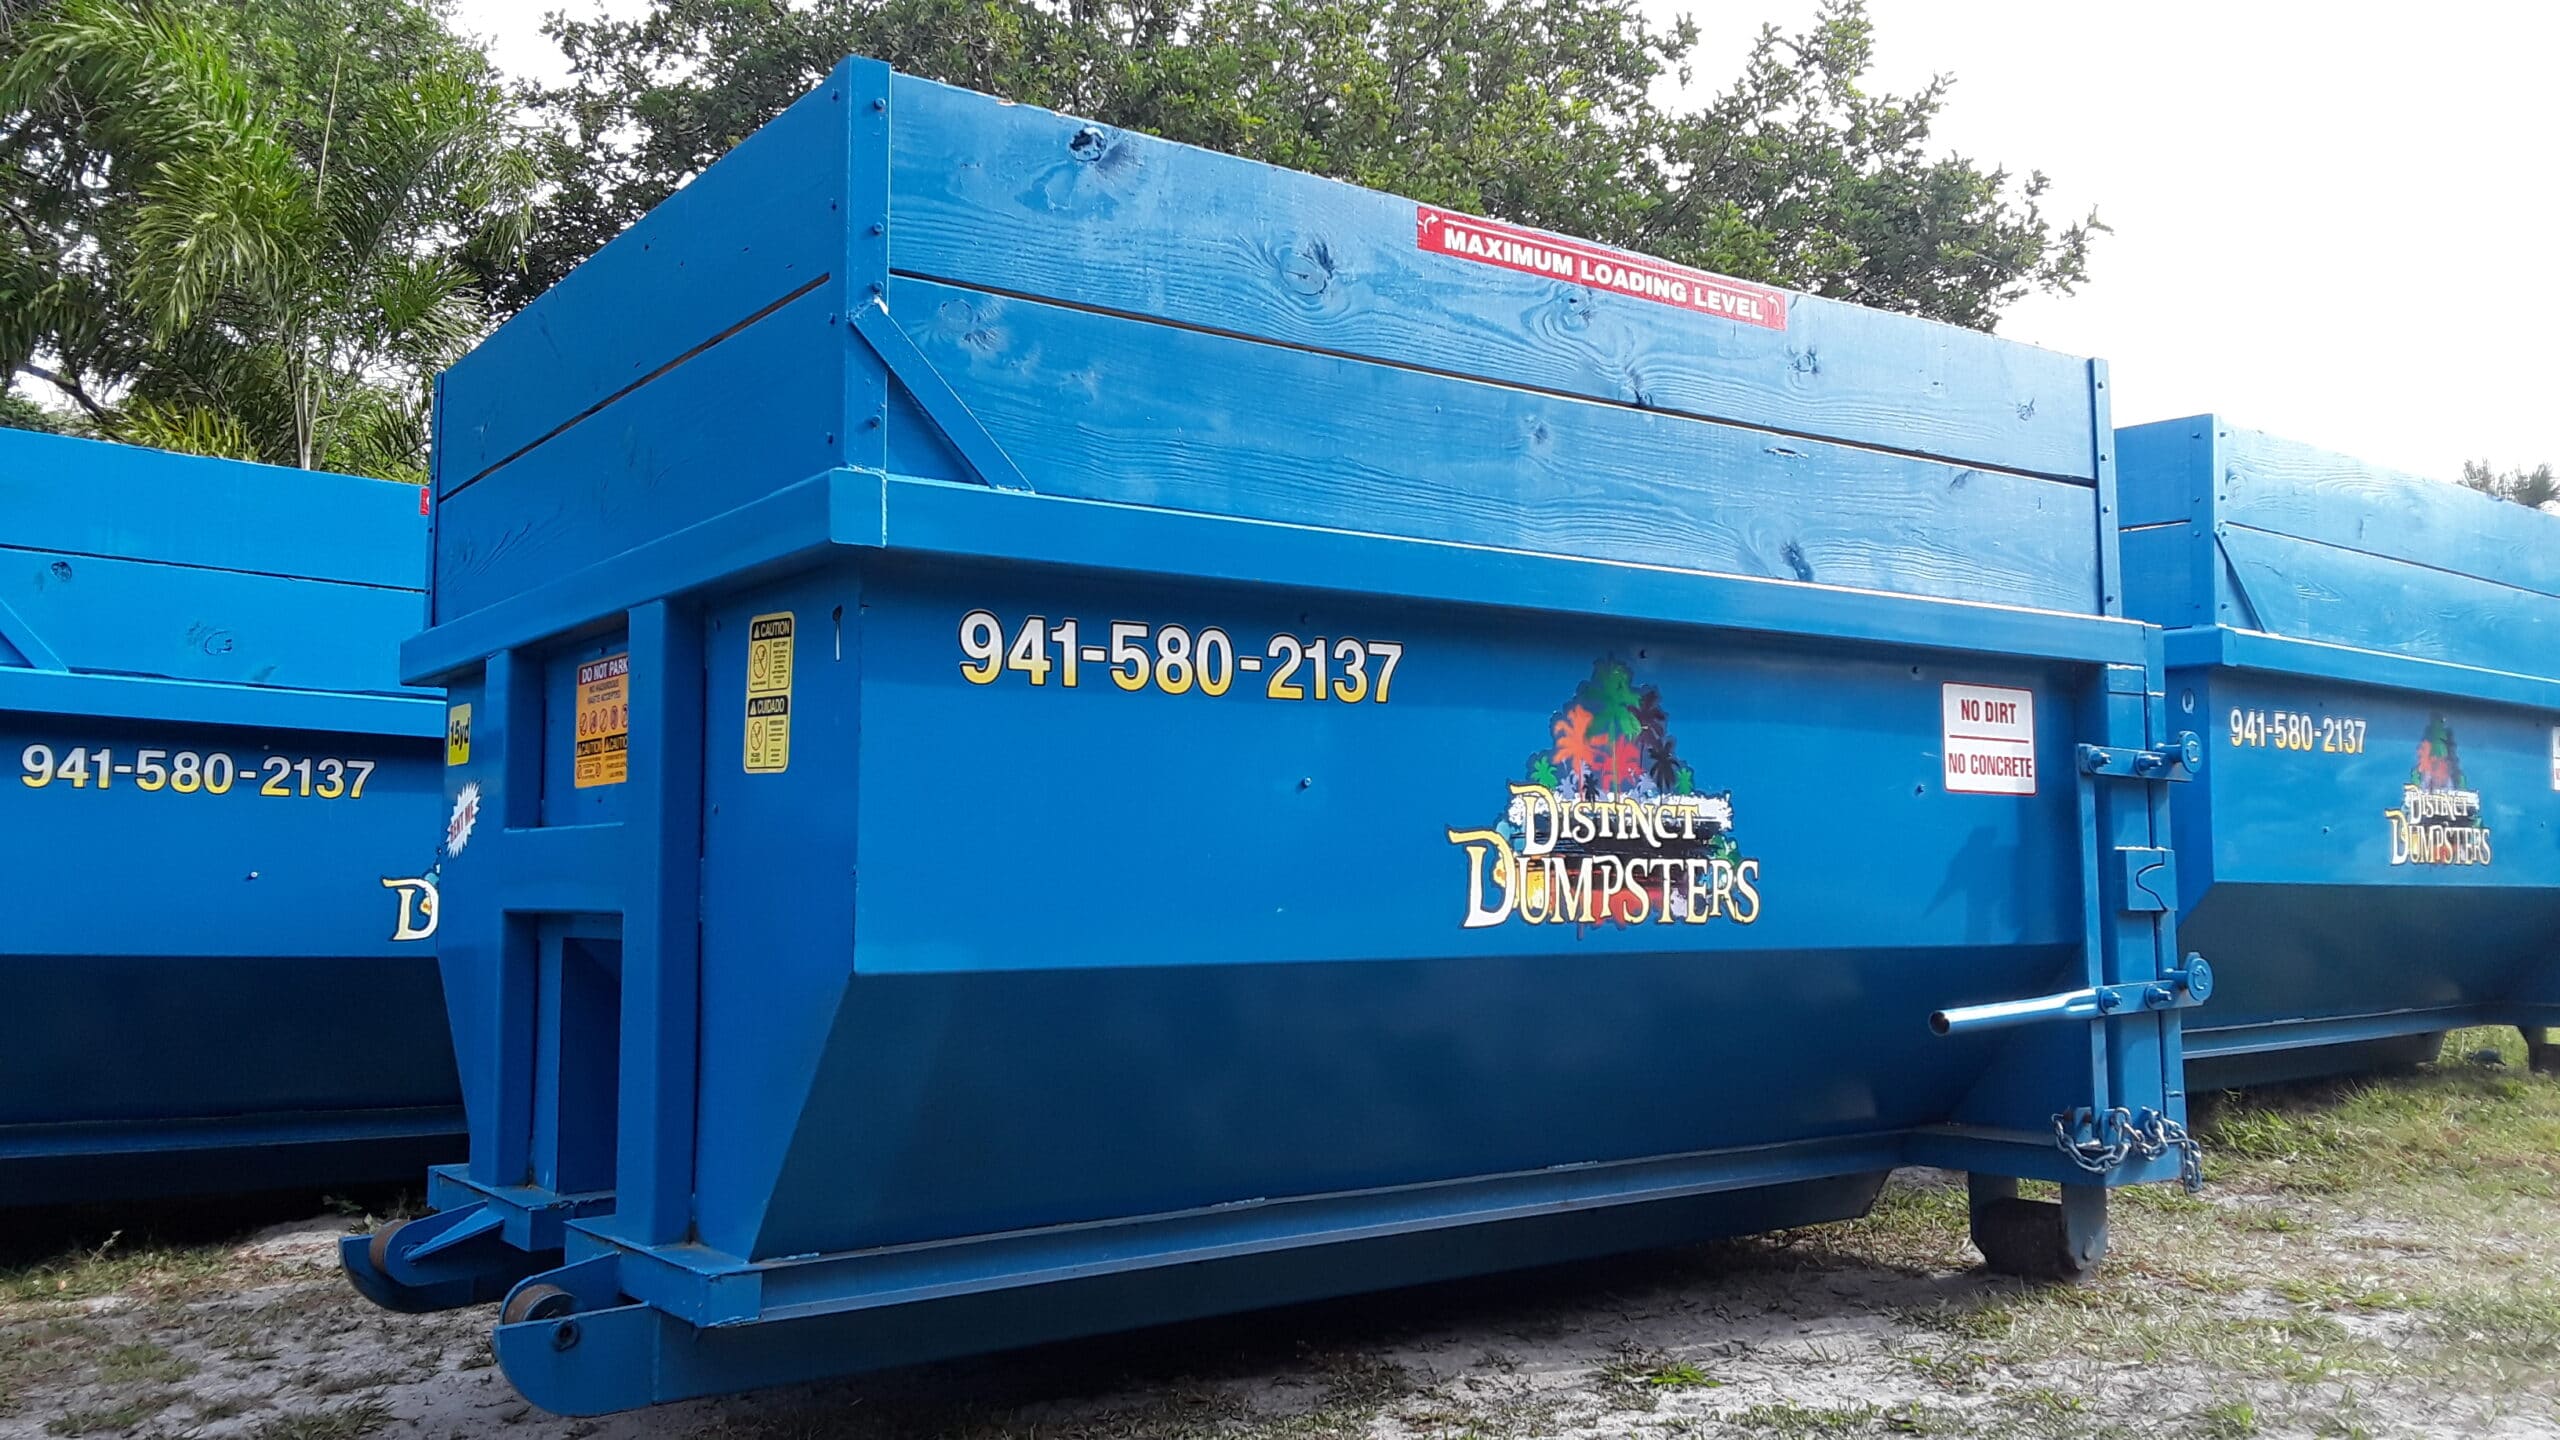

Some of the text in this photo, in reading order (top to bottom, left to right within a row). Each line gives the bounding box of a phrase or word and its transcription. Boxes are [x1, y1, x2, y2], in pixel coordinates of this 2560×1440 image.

[1443, 227, 1765, 321] MAXIMUM LOADING LEVEL
[760, 621, 790, 638] CAUTION
[957, 609, 1404, 704] 941-580-2137
[757, 698, 784, 714] CUIDADO
[1961, 699, 2016, 724] NO DIRT
[451, 716, 469, 751] 15yd
[2230, 708, 2367, 754] 941-580-2137
[21, 743, 376, 799] 941-580-2137
[1948, 753, 2033, 778] NO CONCRETE
[1509, 784, 1702, 856] DISTINCT
[2404, 784, 2470, 825] DISTINCT
[2384, 809, 2492, 866] DUMPSTERS
[1447, 828, 1761, 929] DUMPSTERS
